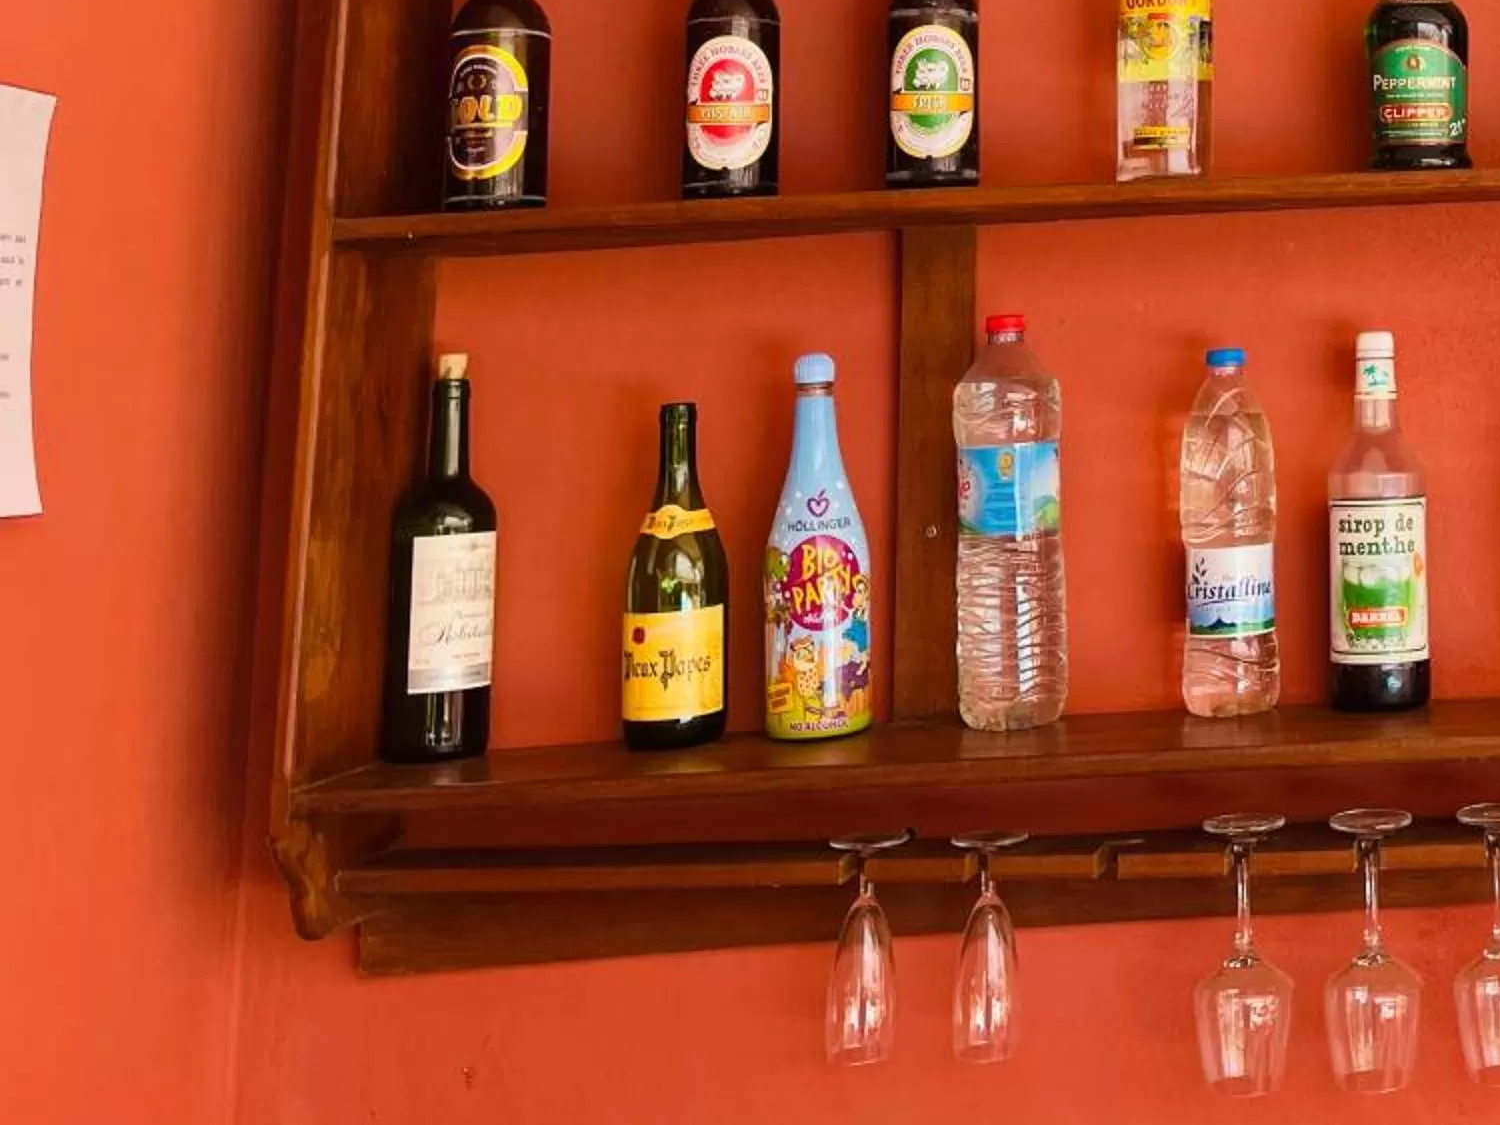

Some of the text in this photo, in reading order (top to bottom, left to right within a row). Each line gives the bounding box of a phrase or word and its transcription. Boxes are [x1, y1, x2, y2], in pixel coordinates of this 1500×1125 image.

[452, 94, 523, 125] OLD
[1383, 107, 1447, 120] CLIPPER
[1338, 513, 1414, 537] sirop de
[1338, 539, 1416, 556] menthe
[802, 544, 838, 581] BIO
[792, 564, 854, 613] PARTY
